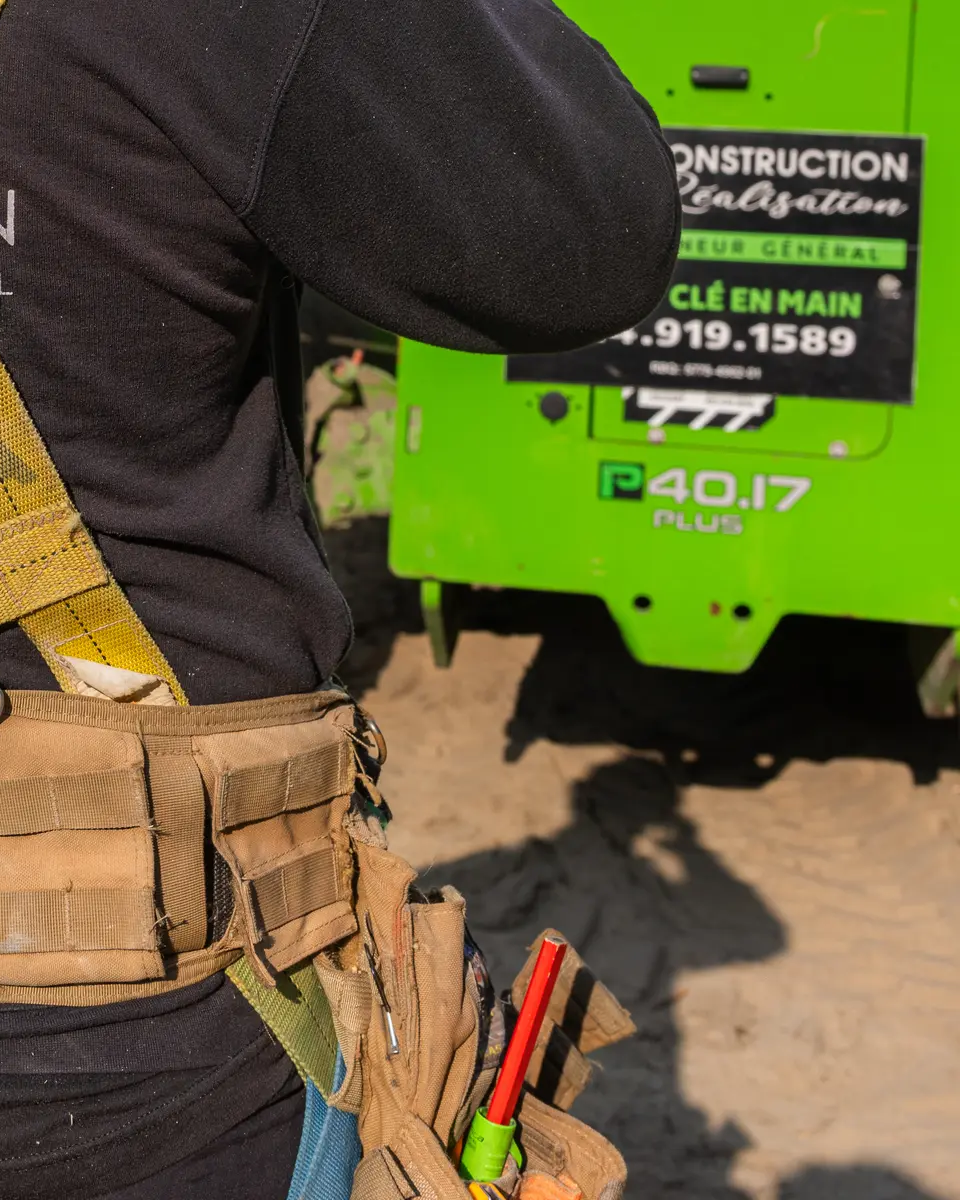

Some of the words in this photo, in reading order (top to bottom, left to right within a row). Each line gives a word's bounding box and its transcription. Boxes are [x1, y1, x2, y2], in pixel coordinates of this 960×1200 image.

[760, 234, 880, 264] GÉNÉRAL
[668, 279, 724, 312] CLÉ
[730, 286, 771, 315] EN
[777, 289, 863, 319] MAIN
[653, 508, 744, 536] PLUS
